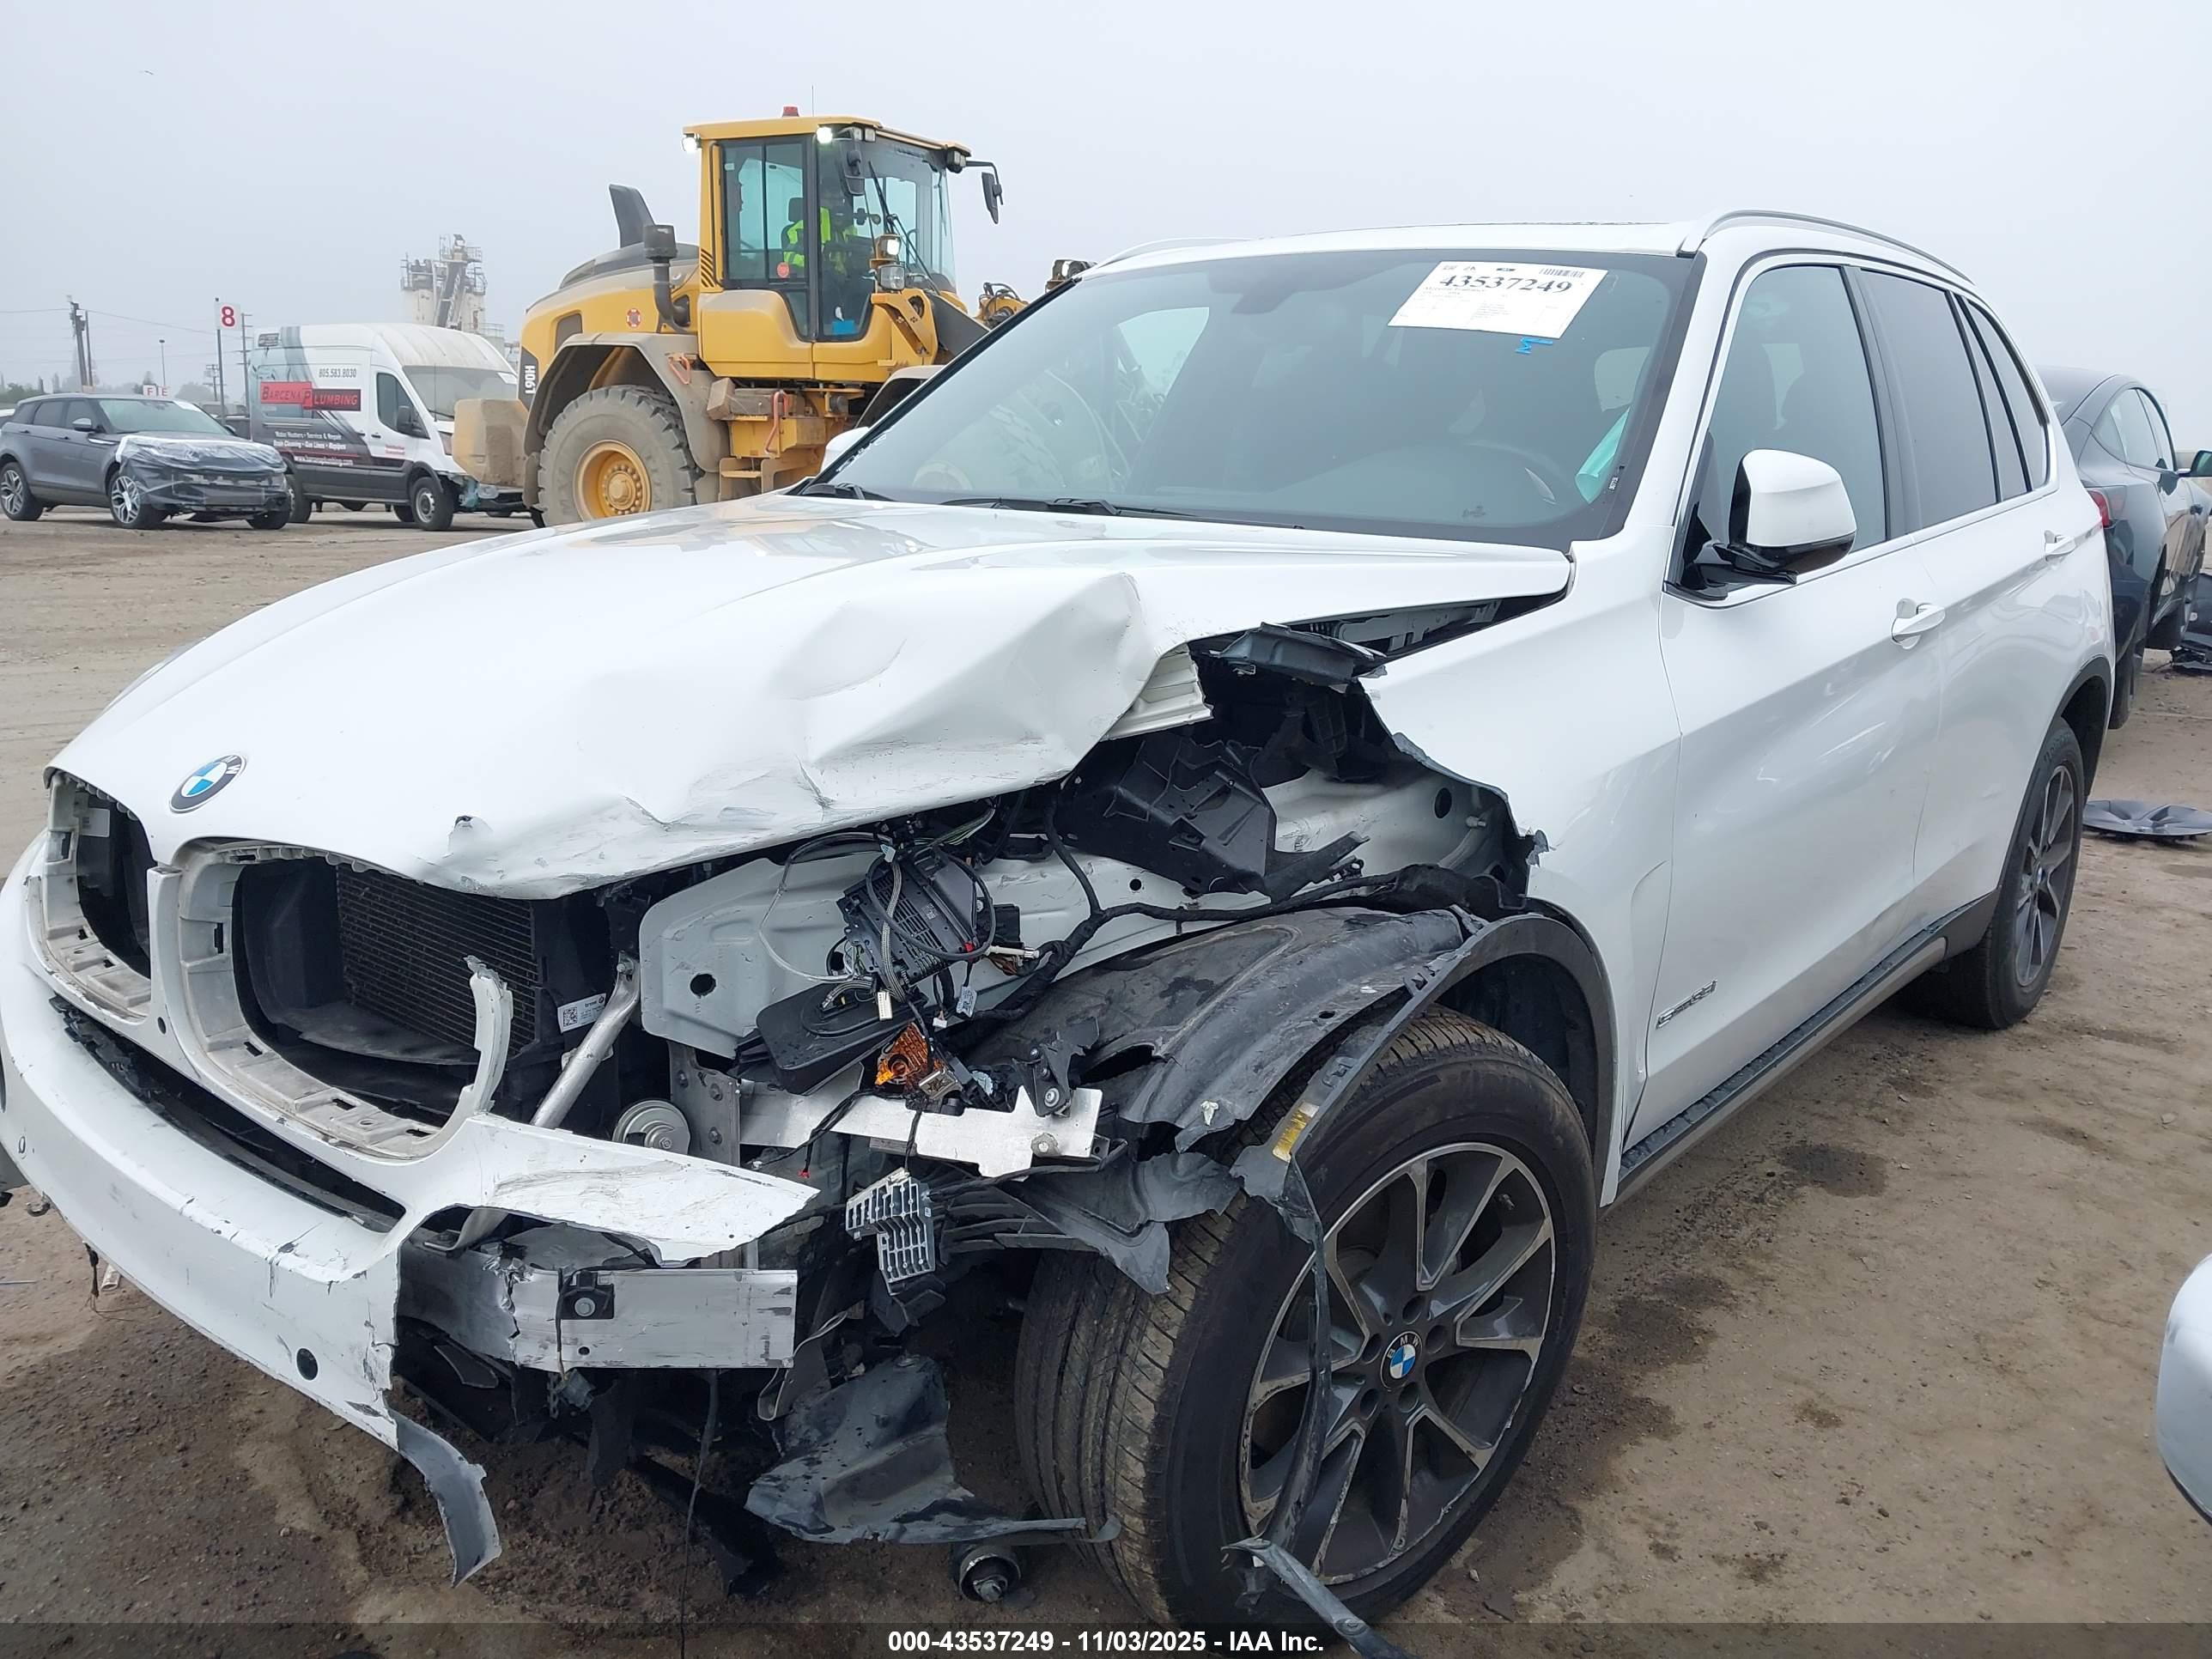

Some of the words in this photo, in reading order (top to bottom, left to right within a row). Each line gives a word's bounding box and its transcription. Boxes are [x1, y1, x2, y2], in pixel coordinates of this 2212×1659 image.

[1439, 275, 1572, 294] 43537249
[221, 306, 235, 327] 8
[525, 365, 537, 394] L90H
